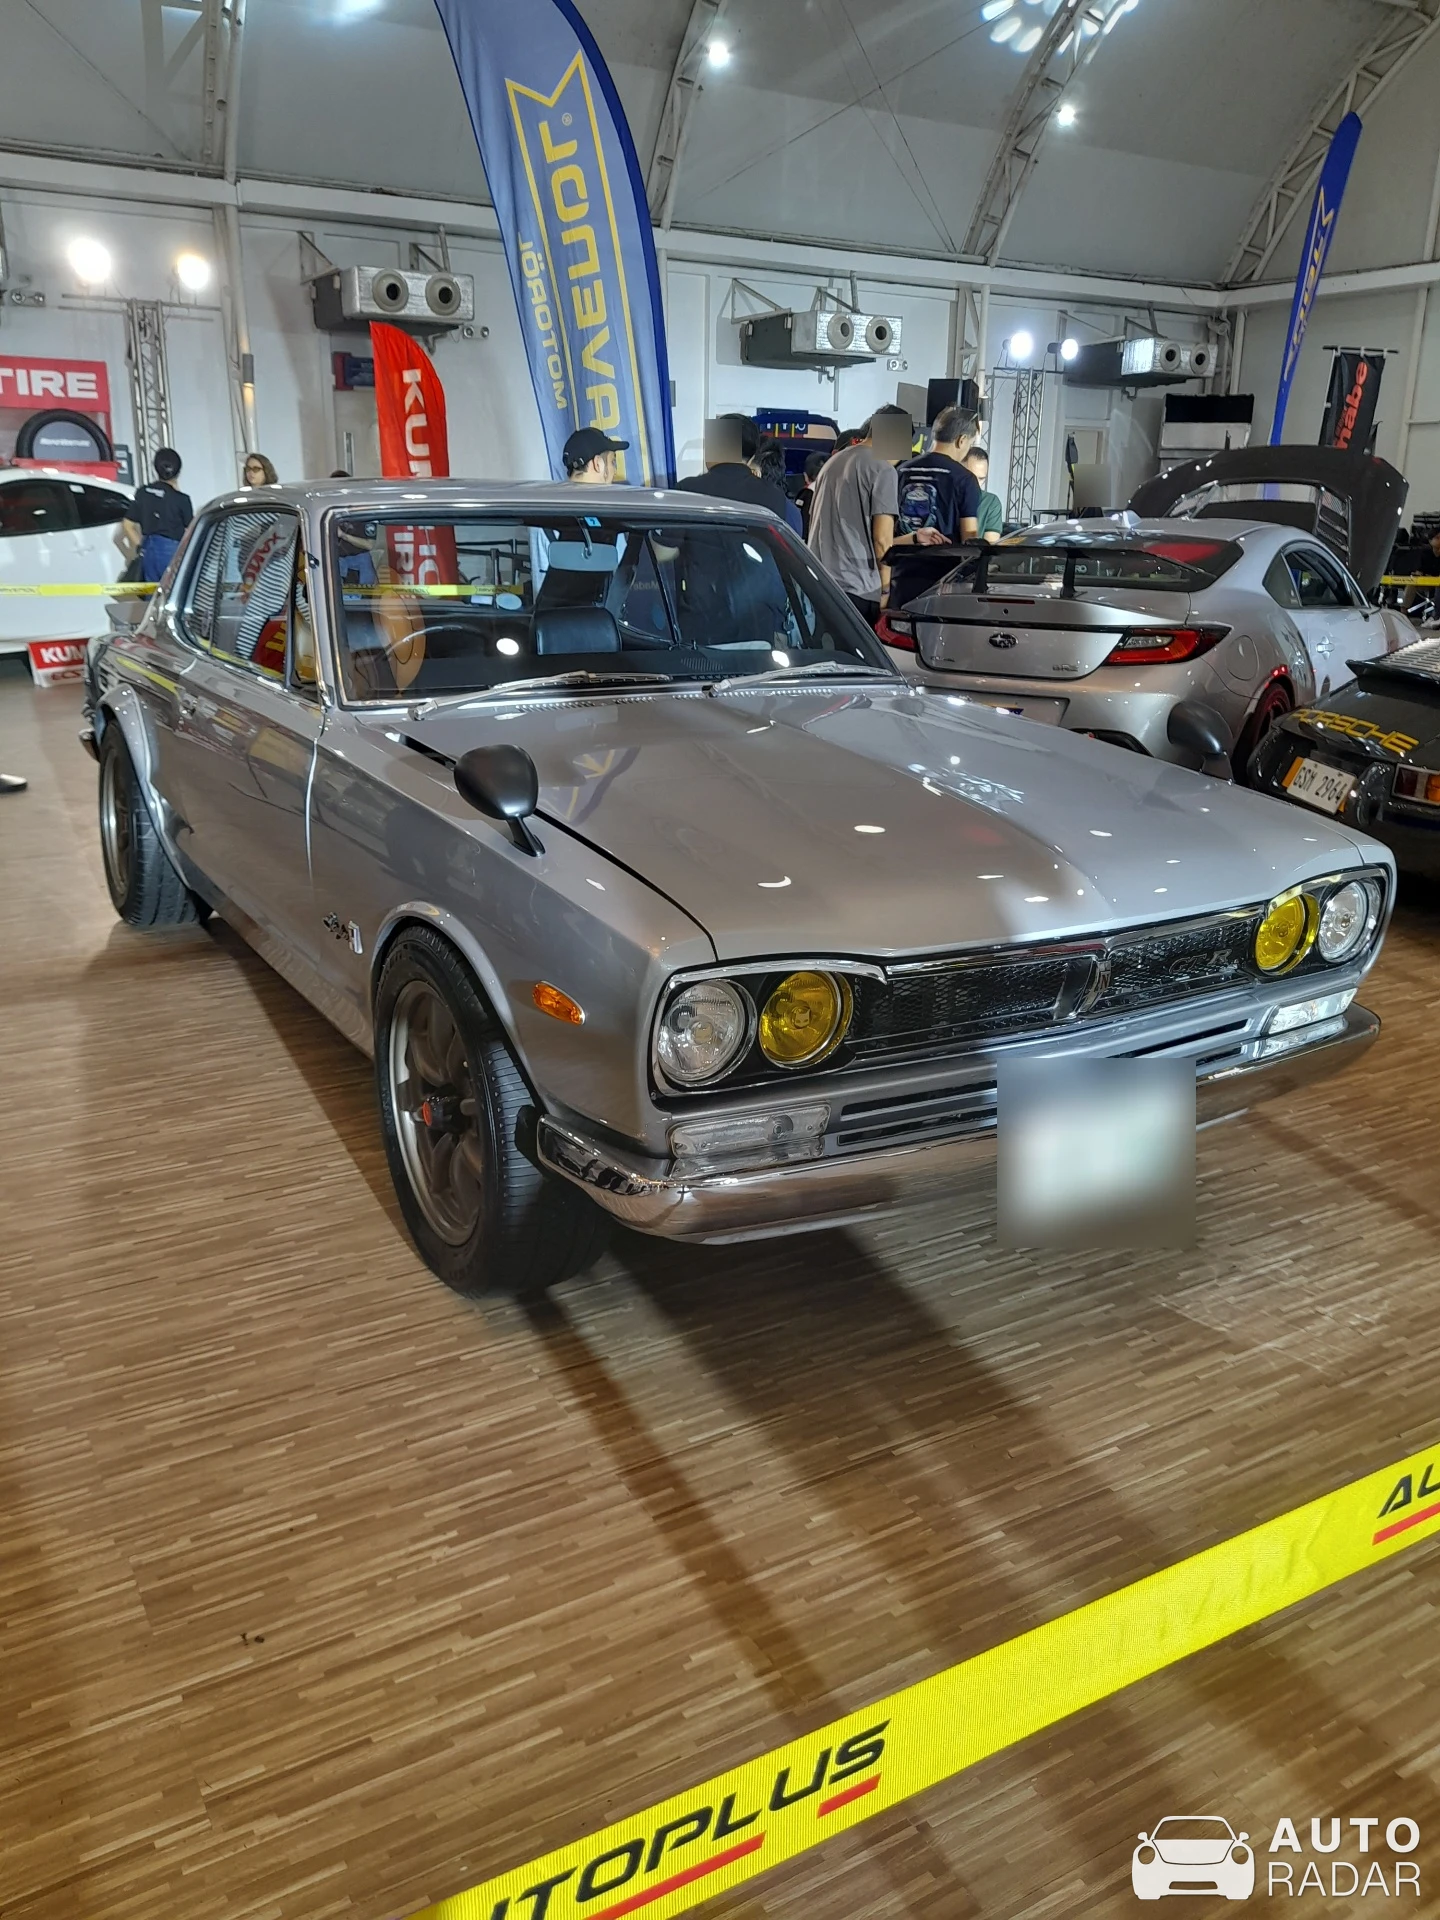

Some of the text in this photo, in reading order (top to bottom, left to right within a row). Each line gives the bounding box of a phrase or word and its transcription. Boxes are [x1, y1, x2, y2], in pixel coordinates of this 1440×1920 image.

[1289, 708, 1420, 754] PORSCHE
[1314, 775, 1348, 805] 2964
[490, 1718, 892, 1920] TOPLUS
